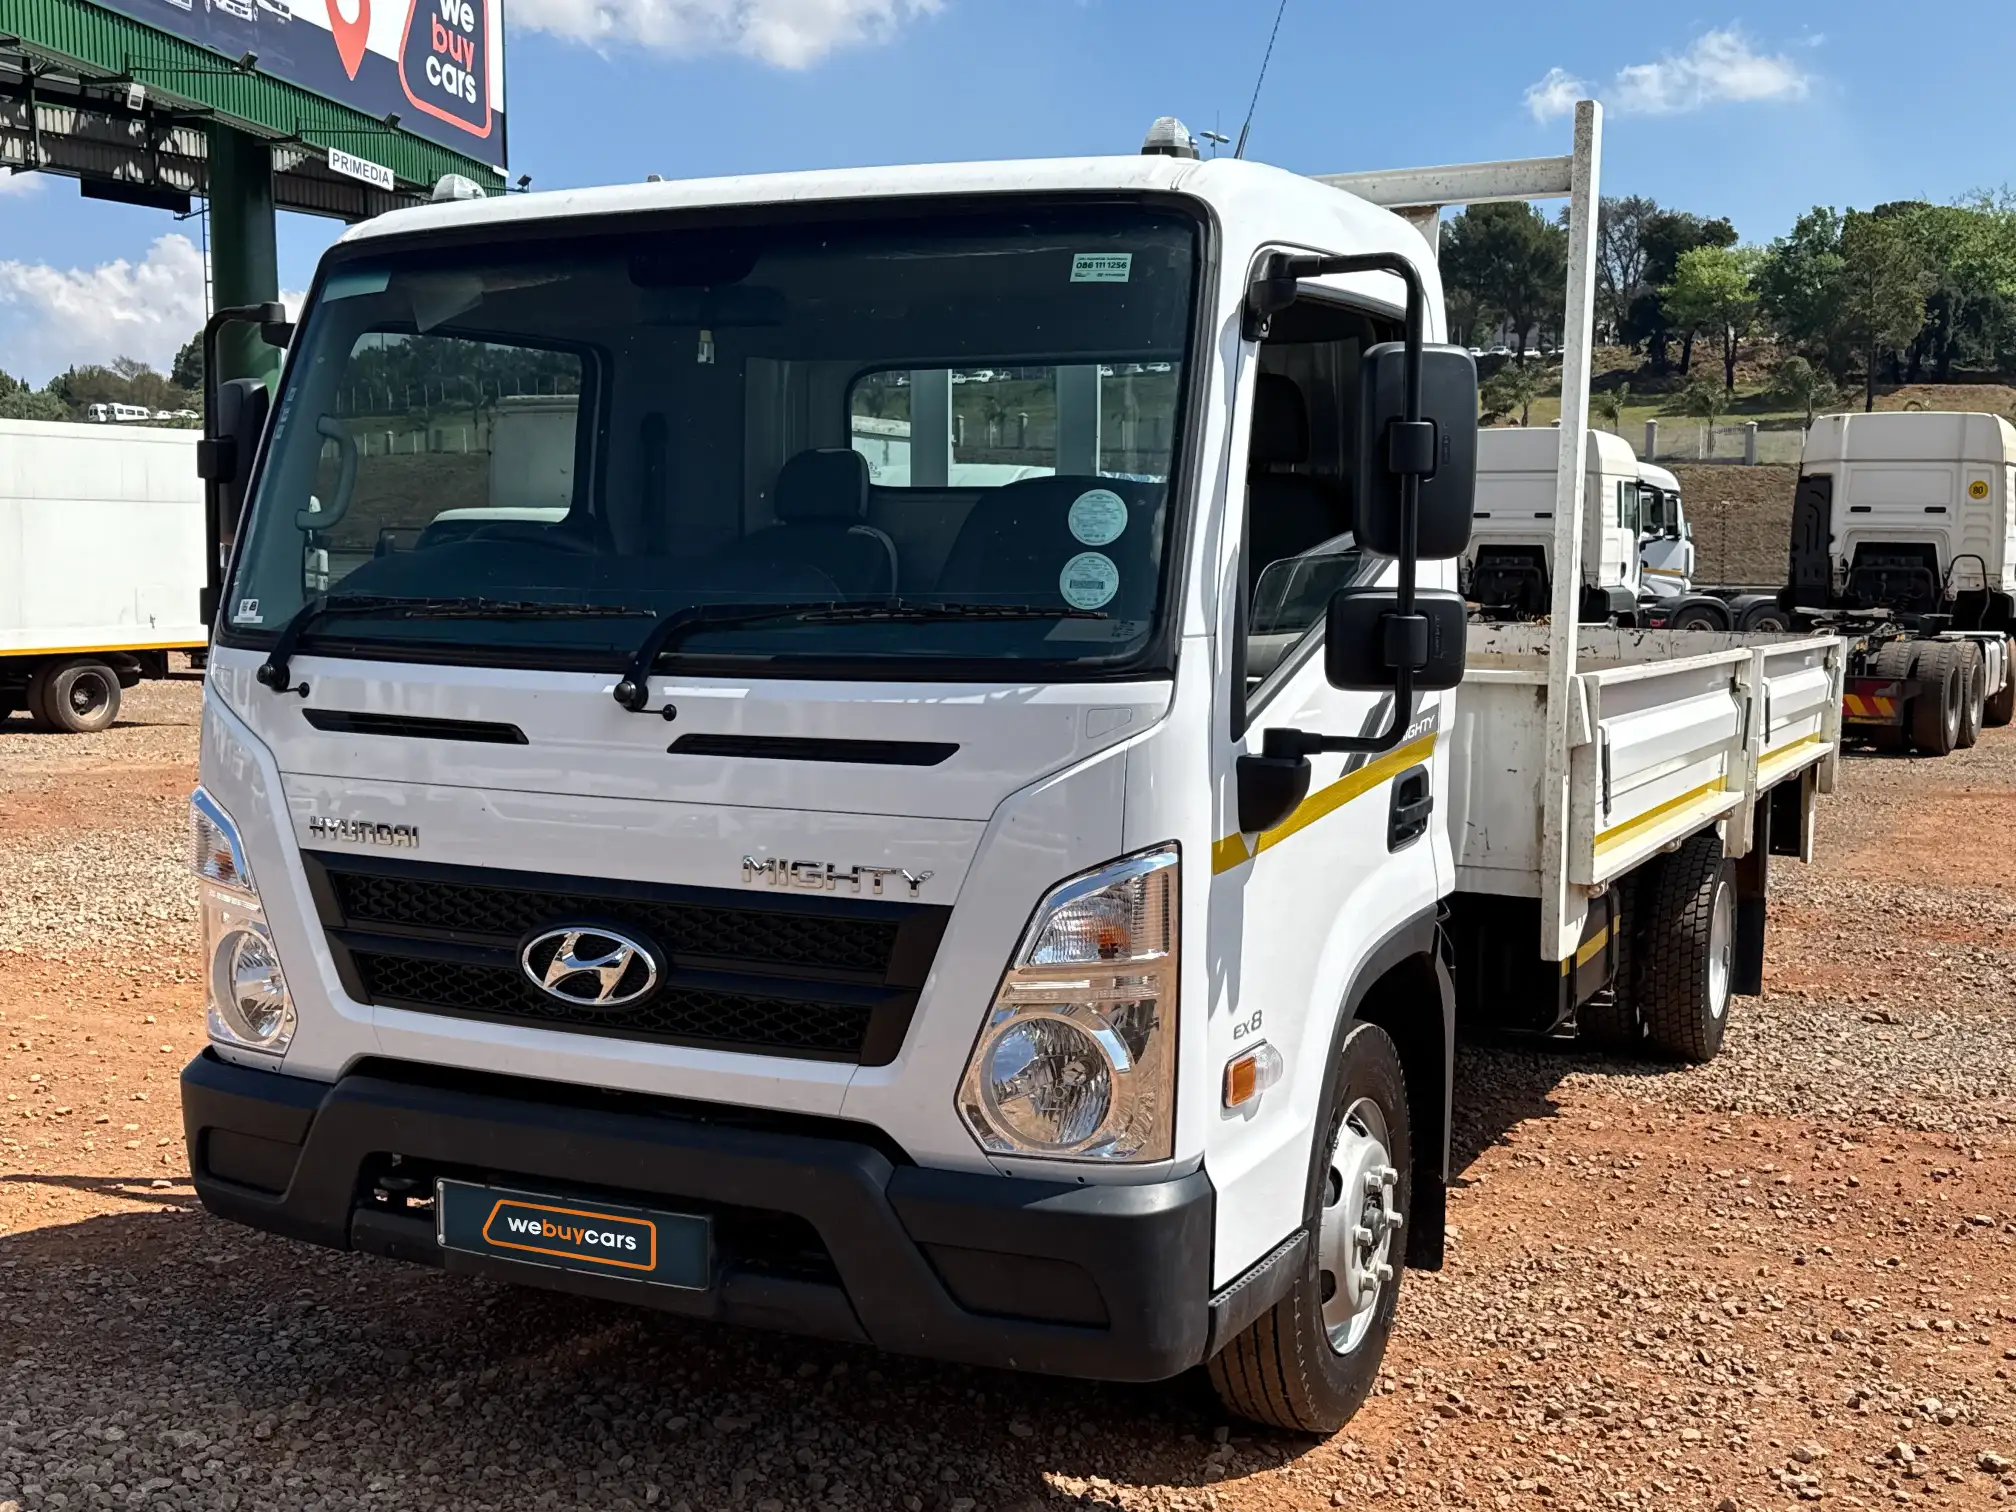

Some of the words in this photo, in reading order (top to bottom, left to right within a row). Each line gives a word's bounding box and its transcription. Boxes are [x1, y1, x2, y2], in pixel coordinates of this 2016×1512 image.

[440, 0, 475, 33] we
[432, 11, 475, 73] buy
[426, 55, 477, 104] cars
[332, 151, 390, 186] PRIMEDIA
[1076, 261, 1094, 269] 086
[1095, 261, 1106, 269] 111
[1107, 261, 1127, 269] 1256
[1973, 485, 1984, 495] 80
[1402, 714, 1436, 742] IGHTY
[309, 815, 420, 849] HYUNDAI
[741, 854, 935, 898] MIGHTY
[1233, 1009, 1263, 1040] EX8
[507, 1216, 637, 1251] webuycars
